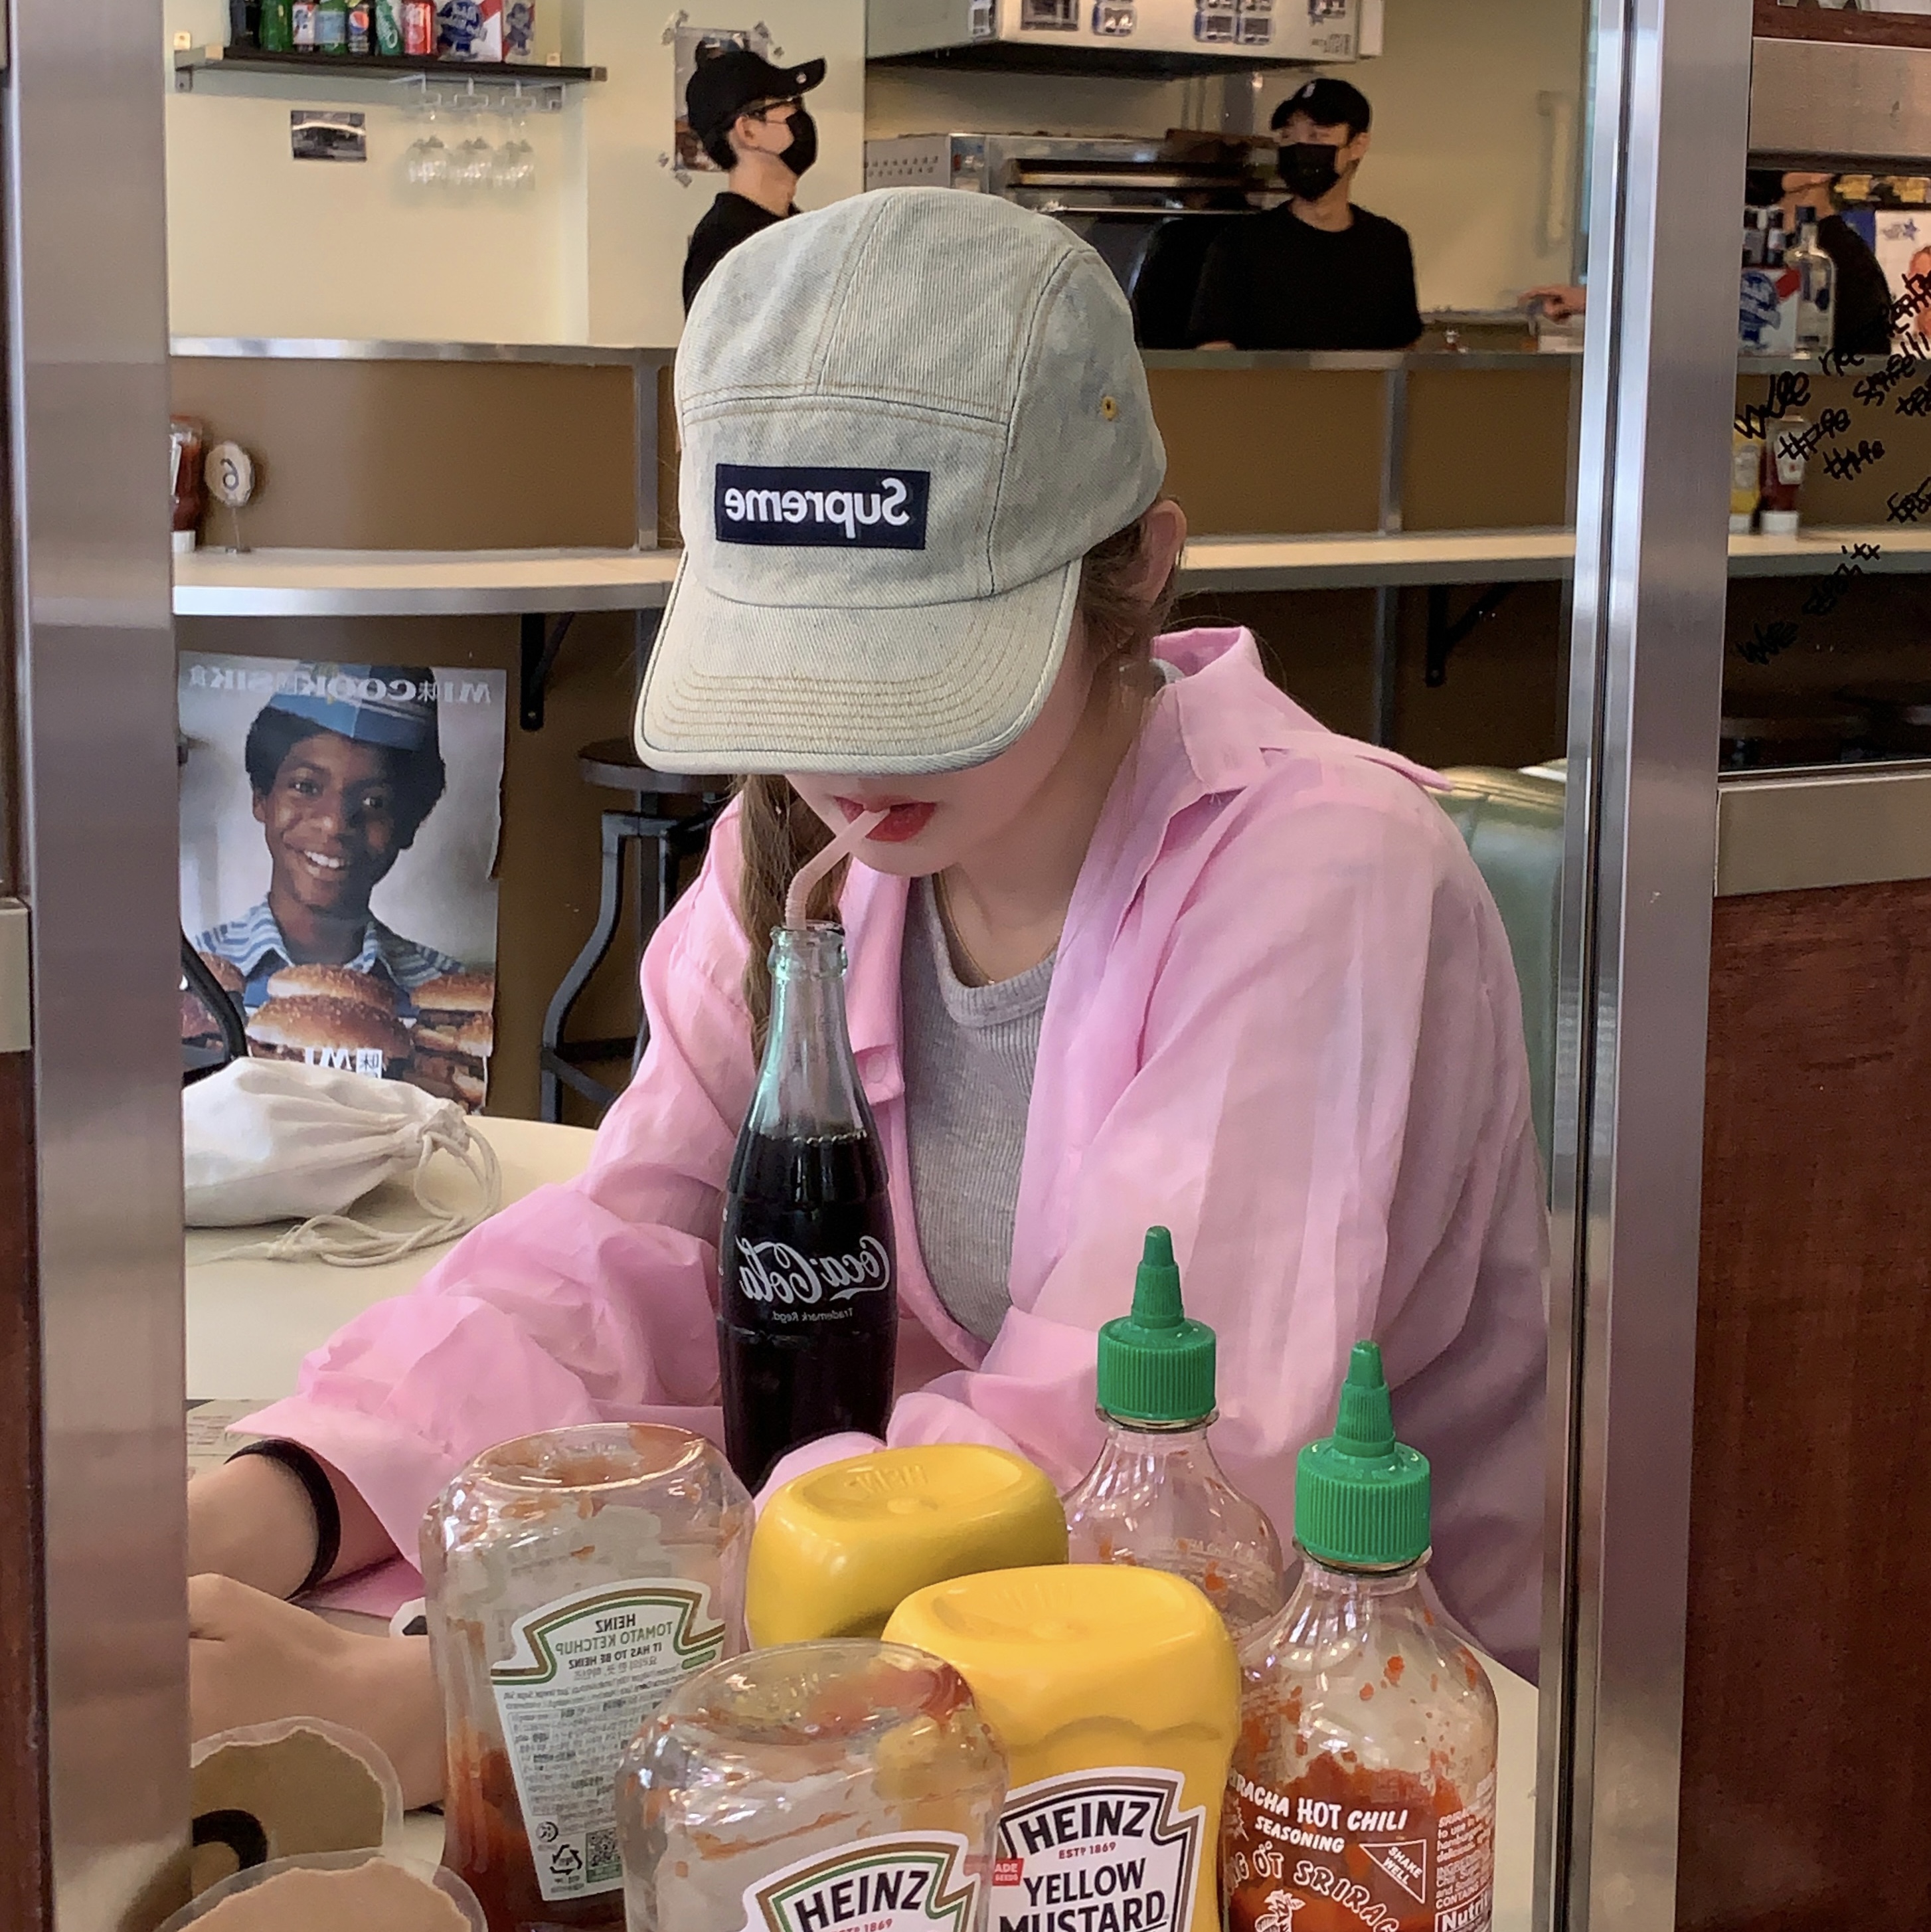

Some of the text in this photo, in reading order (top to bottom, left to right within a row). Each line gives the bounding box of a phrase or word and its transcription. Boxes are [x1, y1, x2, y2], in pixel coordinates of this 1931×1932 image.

[1018, 1800, 1151, 1856] HEINZ
[1297, 1797, 1342, 1831] HOT
[1347, 1809, 1408, 1832] CHILI
[1090, 1841, 1117, 1854] 1869
[1255, 1815, 1345, 1854] SEASONING
[1383, 1858, 1410, 1885] WELL
[1388, 1846, 1423, 1879] SHAKE
[794, 1870, 929, 1932] HEINZ
[1023, 1858, 1146, 1907] YELLOW
